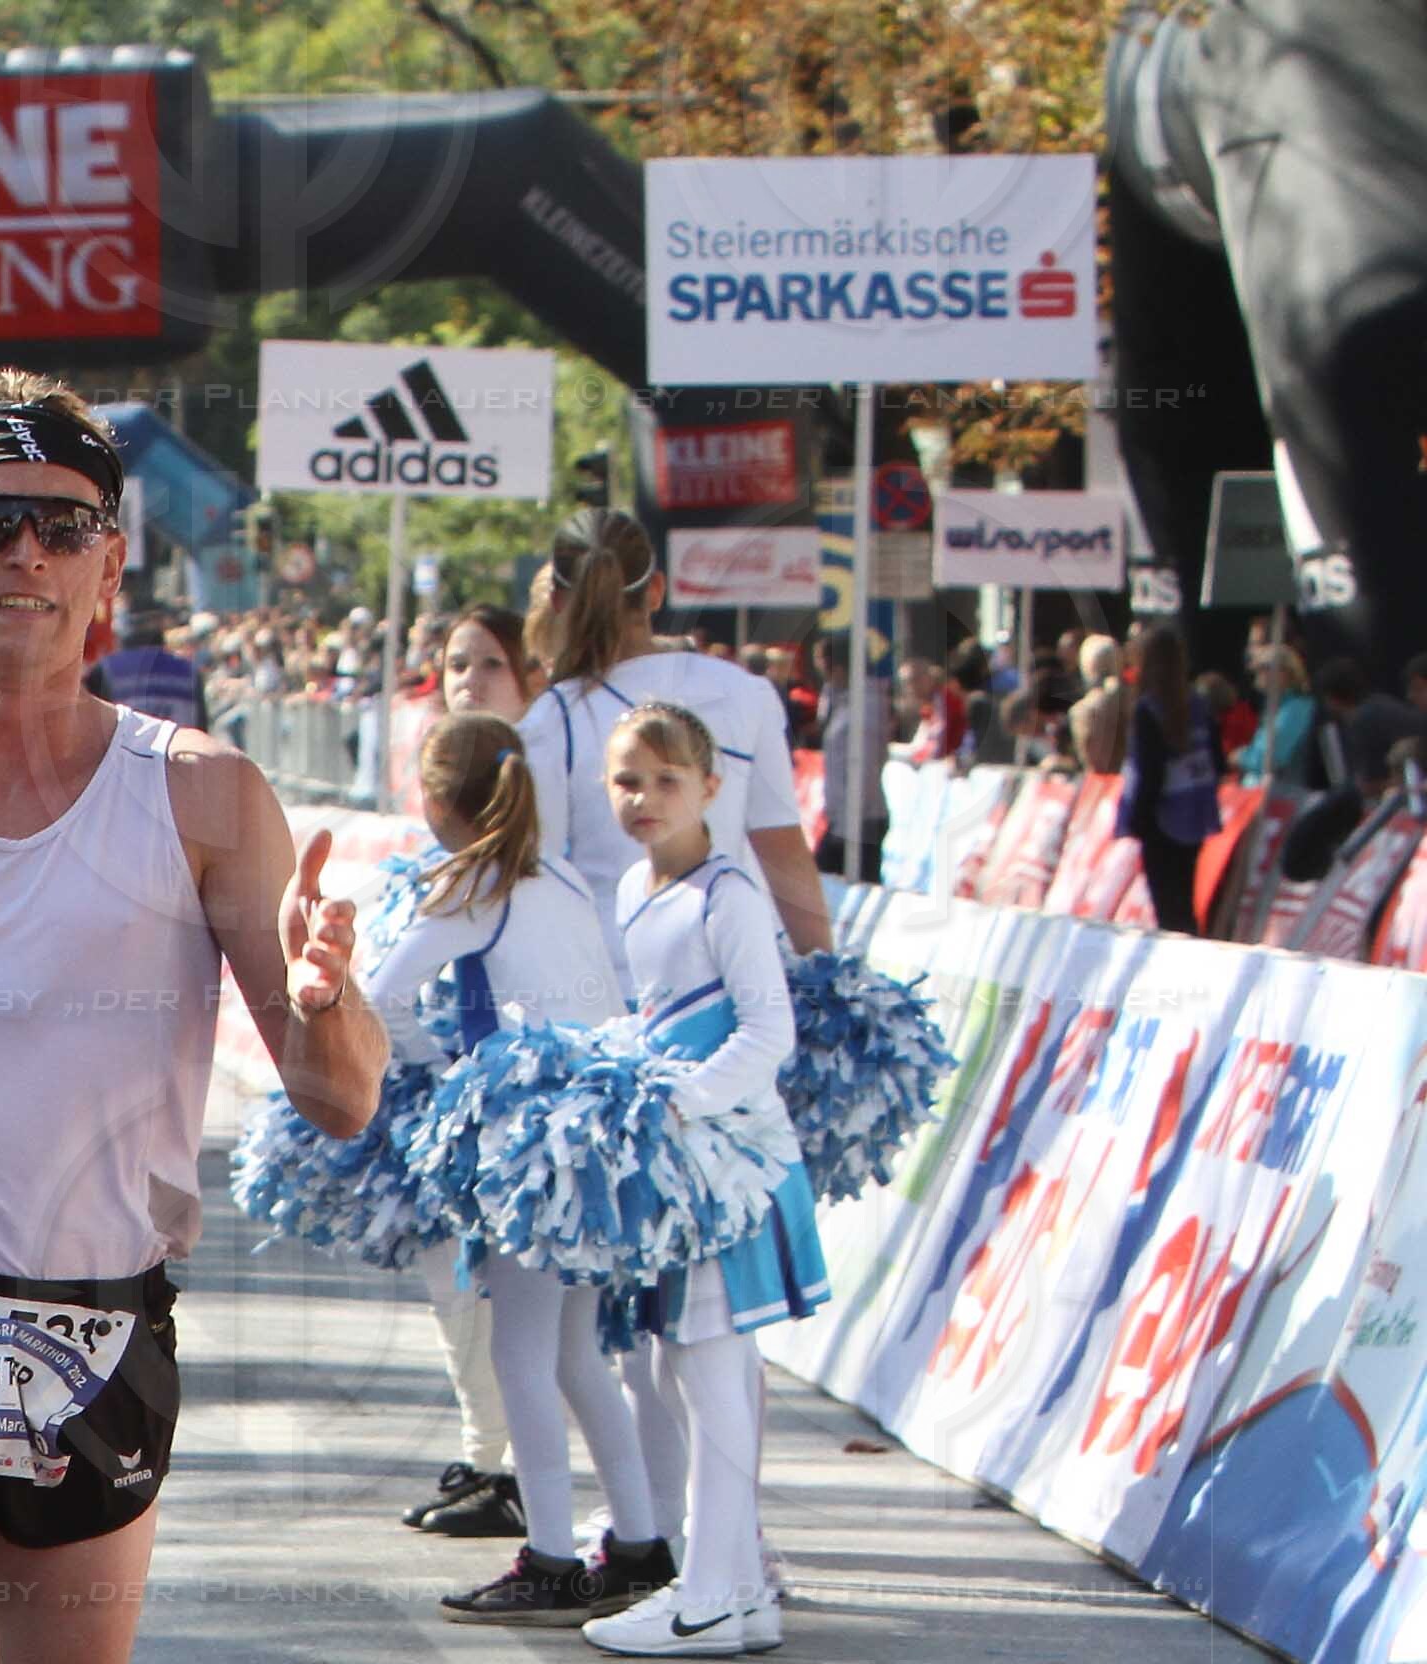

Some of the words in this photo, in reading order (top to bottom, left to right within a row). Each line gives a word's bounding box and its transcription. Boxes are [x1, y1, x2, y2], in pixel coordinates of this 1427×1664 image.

[667, 219, 1010, 259] Steiermärkische
[667, 271, 1010, 323] SPARKASSE
[309, 440, 499, 488] adidas
[113, 1468, 153, 1489] erima
